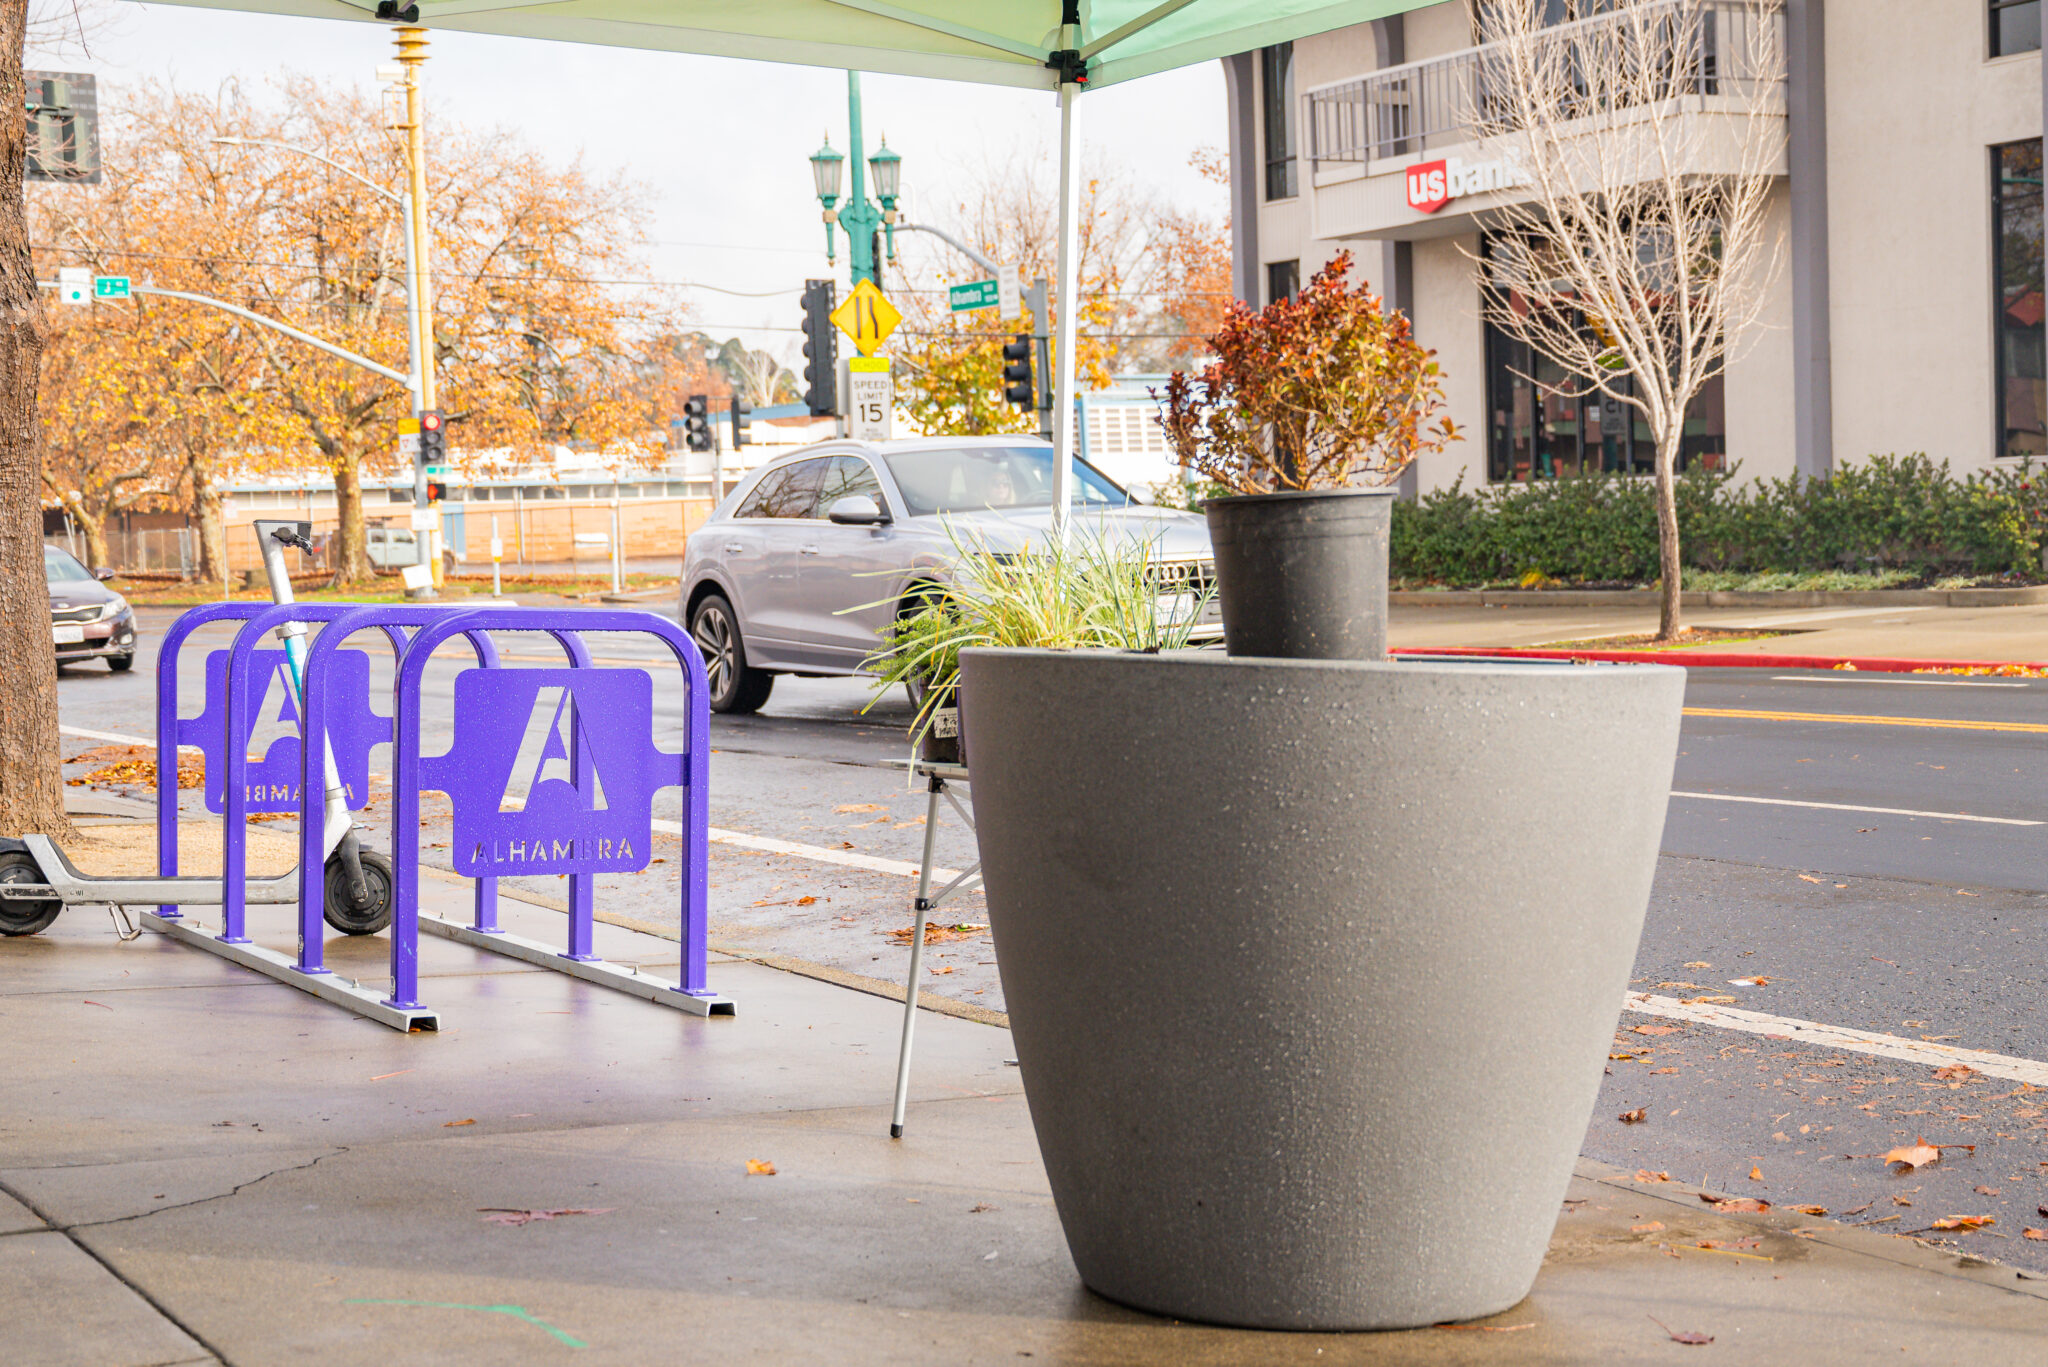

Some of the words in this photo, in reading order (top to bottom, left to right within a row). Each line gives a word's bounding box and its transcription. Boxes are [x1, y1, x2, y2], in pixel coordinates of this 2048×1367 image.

[853, 361, 886, 370] SCHOOL
[854, 380, 888, 390] SPEED
[857, 391, 884, 401] LIMIT
[859, 403, 883, 422] 15
[498, 686, 609, 813] A
[470, 837, 634, 864] ALHAMBRA
